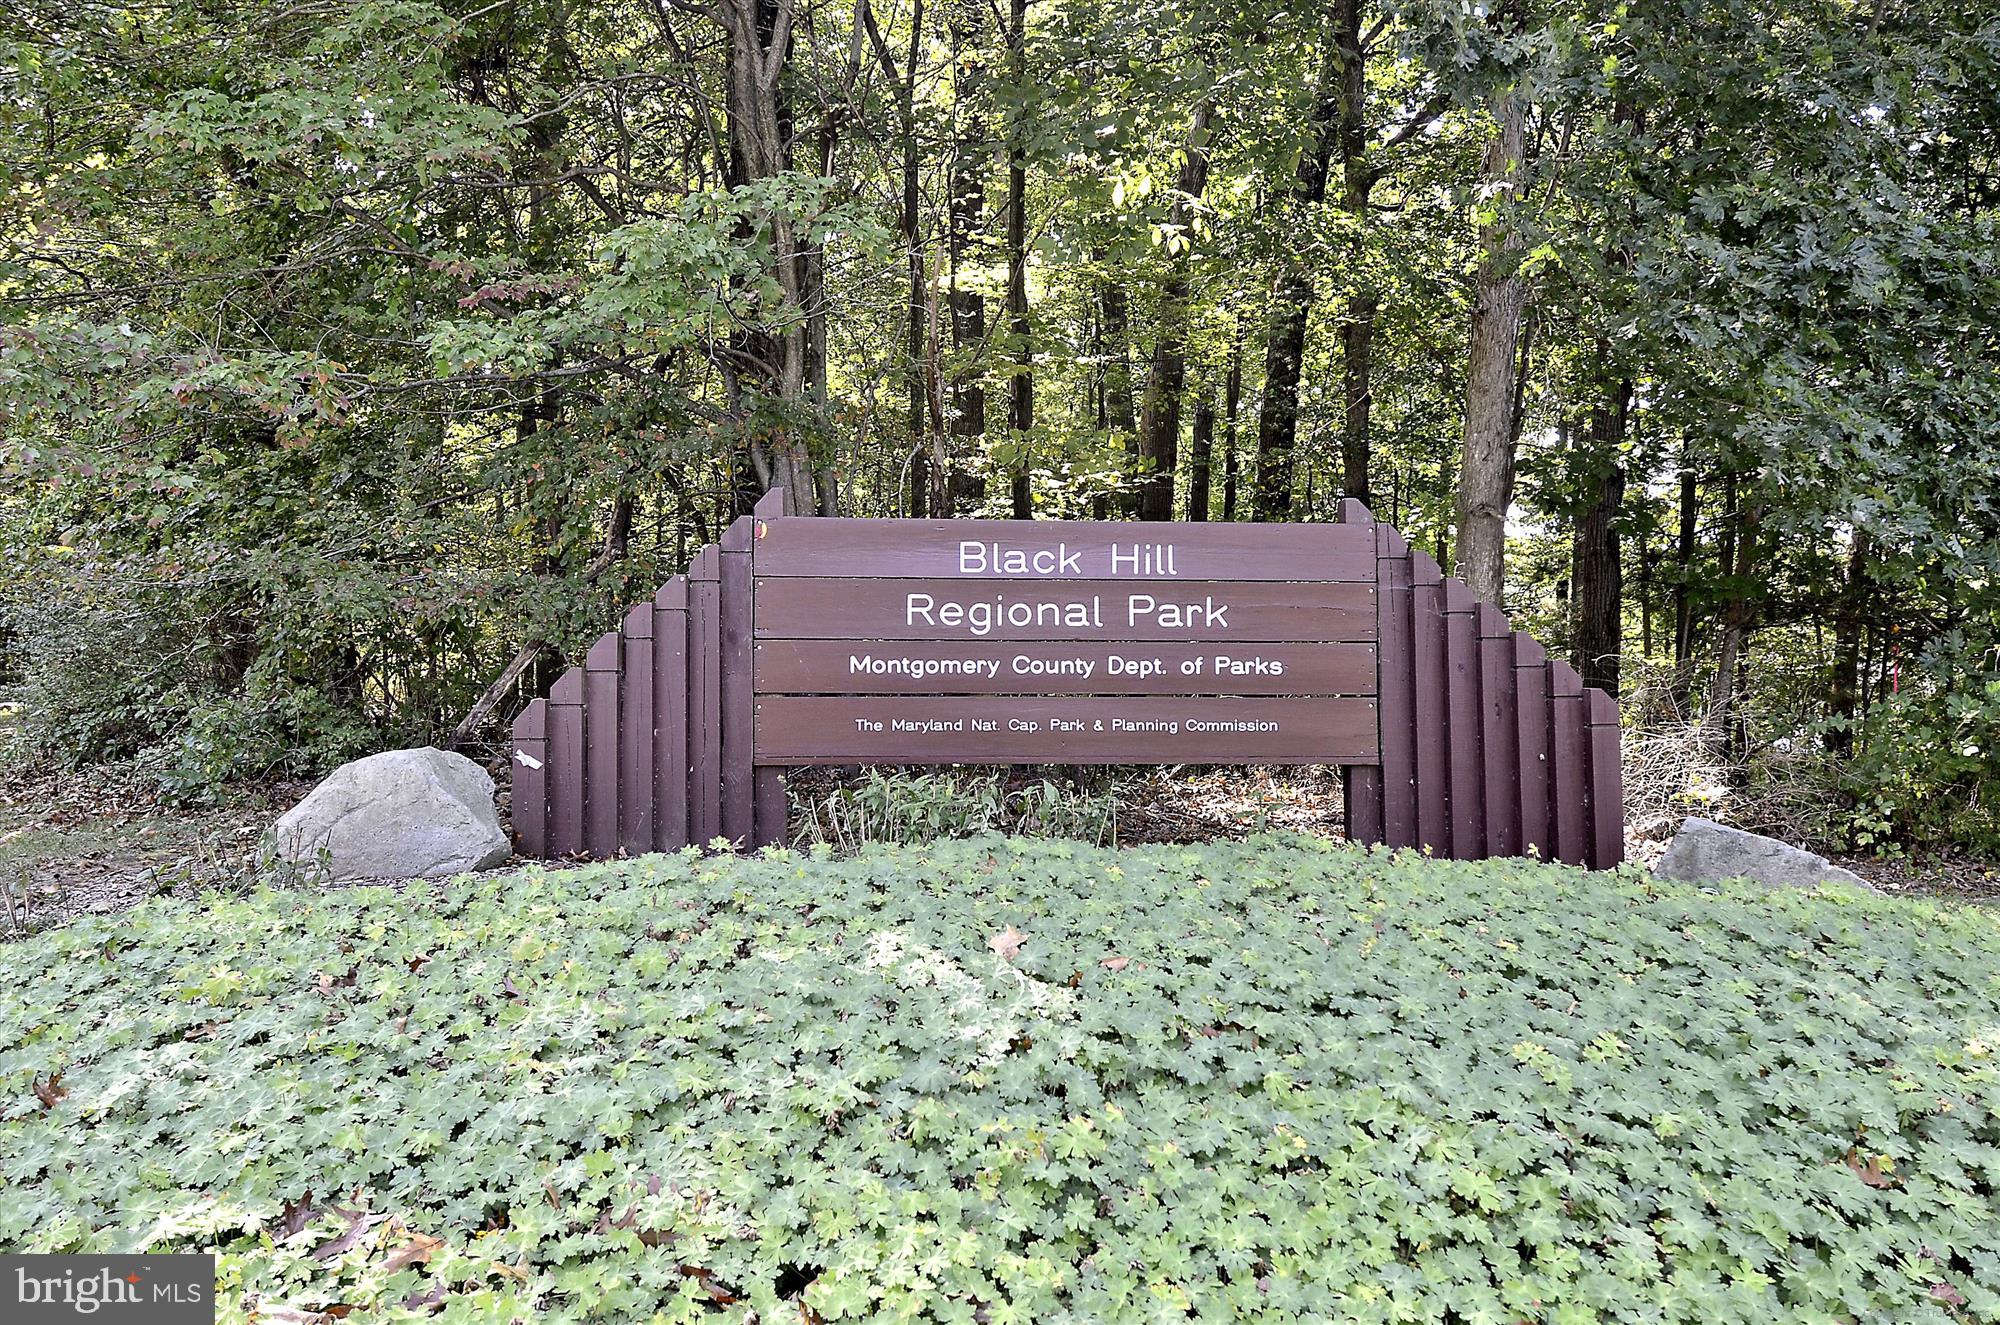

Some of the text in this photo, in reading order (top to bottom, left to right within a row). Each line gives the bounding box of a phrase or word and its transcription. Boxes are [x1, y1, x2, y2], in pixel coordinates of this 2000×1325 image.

[958, 540, 1178, 576] Black Hill
[905, 593, 1229, 636] Regional Park
[849, 655, 1284, 679] Montgomery County Dept. of Parks
[855, 718, 1279, 735] The Maryland Nat. Cap. Park & Planning Commission
